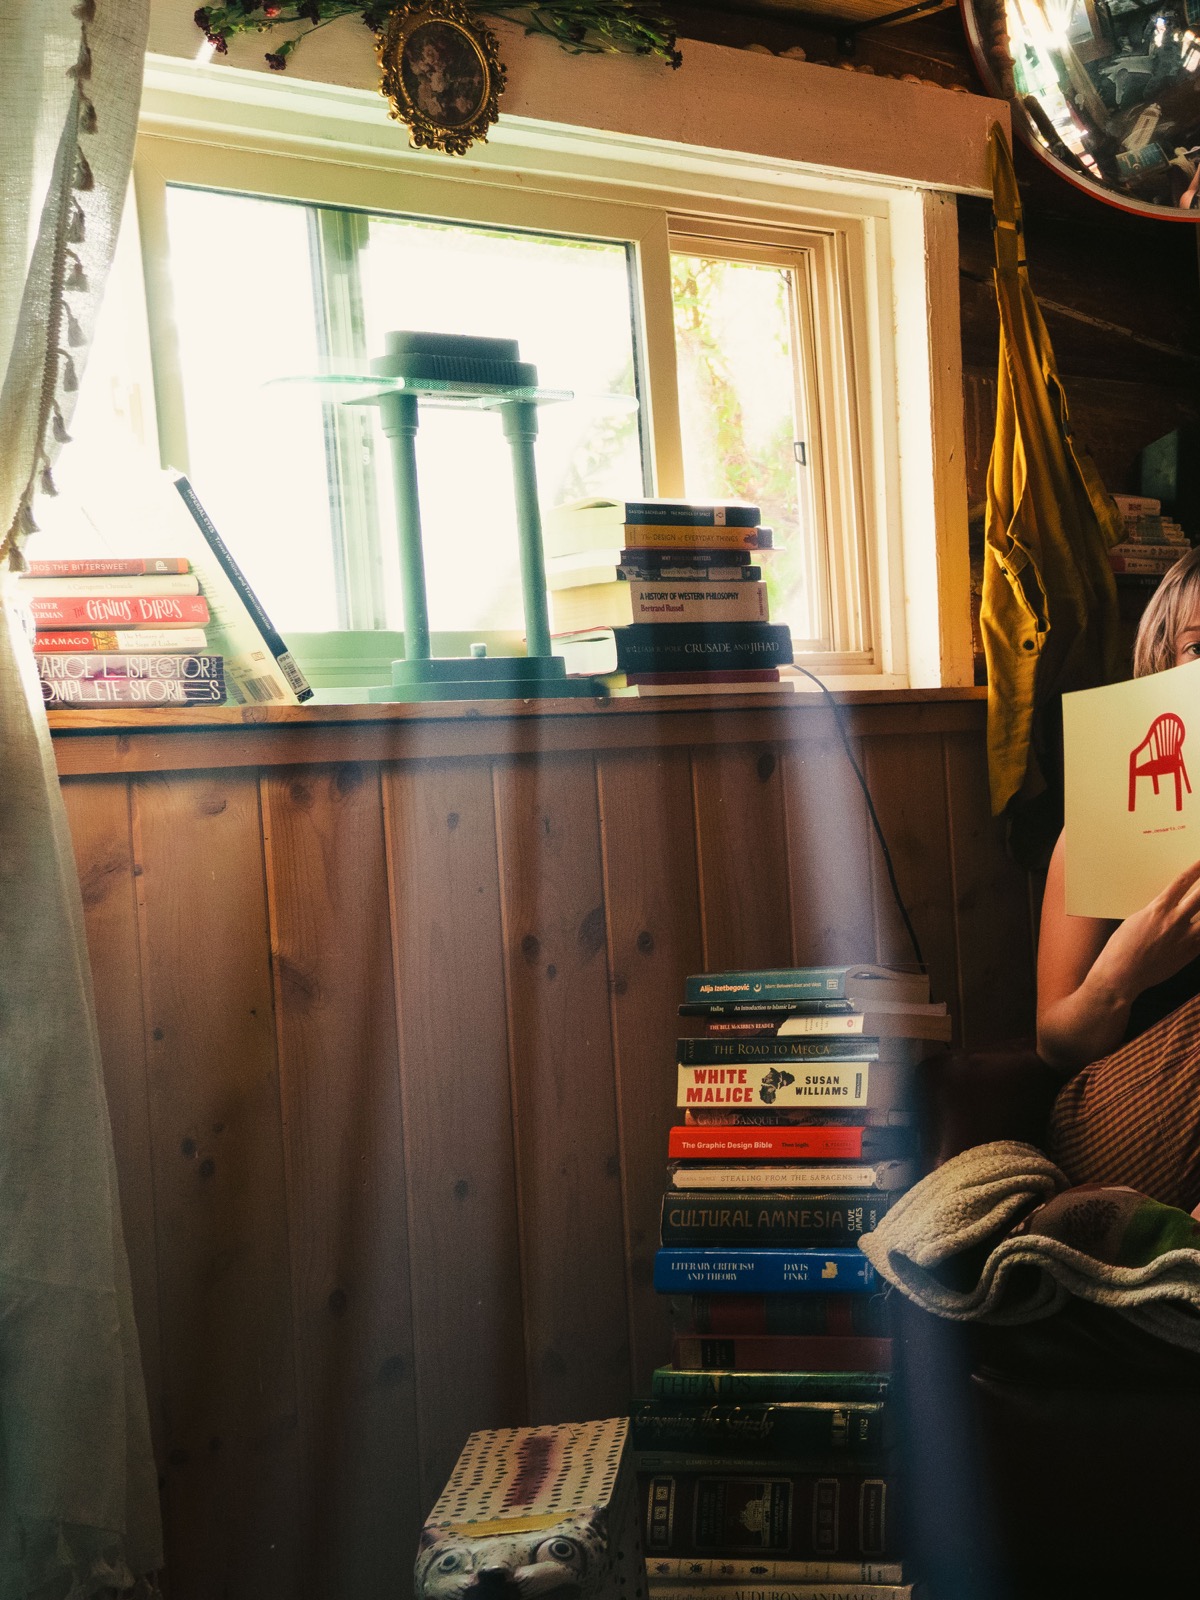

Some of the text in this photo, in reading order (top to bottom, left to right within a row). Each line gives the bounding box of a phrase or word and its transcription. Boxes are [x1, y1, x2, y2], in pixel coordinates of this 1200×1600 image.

[186, 488, 206, 520] IMPERIAL
[202, 518, 216, 534] EYES
[653, 533, 739, 543] DESIGN EVERYDAY THINGS
[52, 562, 129, 572] THE BITTERSWEET
[639, 591, 739, 601] A HISTORY OF WESTERN PHILOSOPHY
[86, 598, 183, 621] GENIUS BIRDS
[640, 604, 685, 612] Bertrand Russell
[684, 642, 780, 655] CRUSADE AND JIHAD
[103, 656, 211, 679] LISPECTOR
[130, 679, 221, 701] STORIES
[699, 983, 750, 994] Alija Izetbegović
[710, 1005, 725, 1013] Hallaq
[730, 1022, 755, 1030] McKIBBEN
[754, 1021, 775, 1029] READER
[713, 1043, 831, 1056] THE ROAD TO MECCA
[693, 1068, 748, 1085] WHITE
[804, 1075, 840, 1085] SUSAN
[685, 1086, 754, 1103] MALICE
[794, 1085, 849, 1096] WILLIAMS
[732, 1113, 781, 1126] BANQUET
[681, 1140, 774, 1151] The Graphic Design Bible
[719, 1173, 854, 1183] STEALING FROM THE SARACENS
[668, 1208, 844, 1229] CULTURAL AMNESIA
[847, 1208, 855, 1232] CLIVE
[855, 1206, 863, 1233] JAMES
[671, 1261, 756, 1272] LITERARY CRITICISM
[783, 1262, 809, 1272] DAVIS
[686, 1272, 739, 1282] AND THEORY
[783, 1272, 810, 1282] FINKE
[655, 1376, 698, 1394] THE
[702, 1376, 751, 1394] ALPS
[685, 1459, 713, 1467] ELEMENTS
